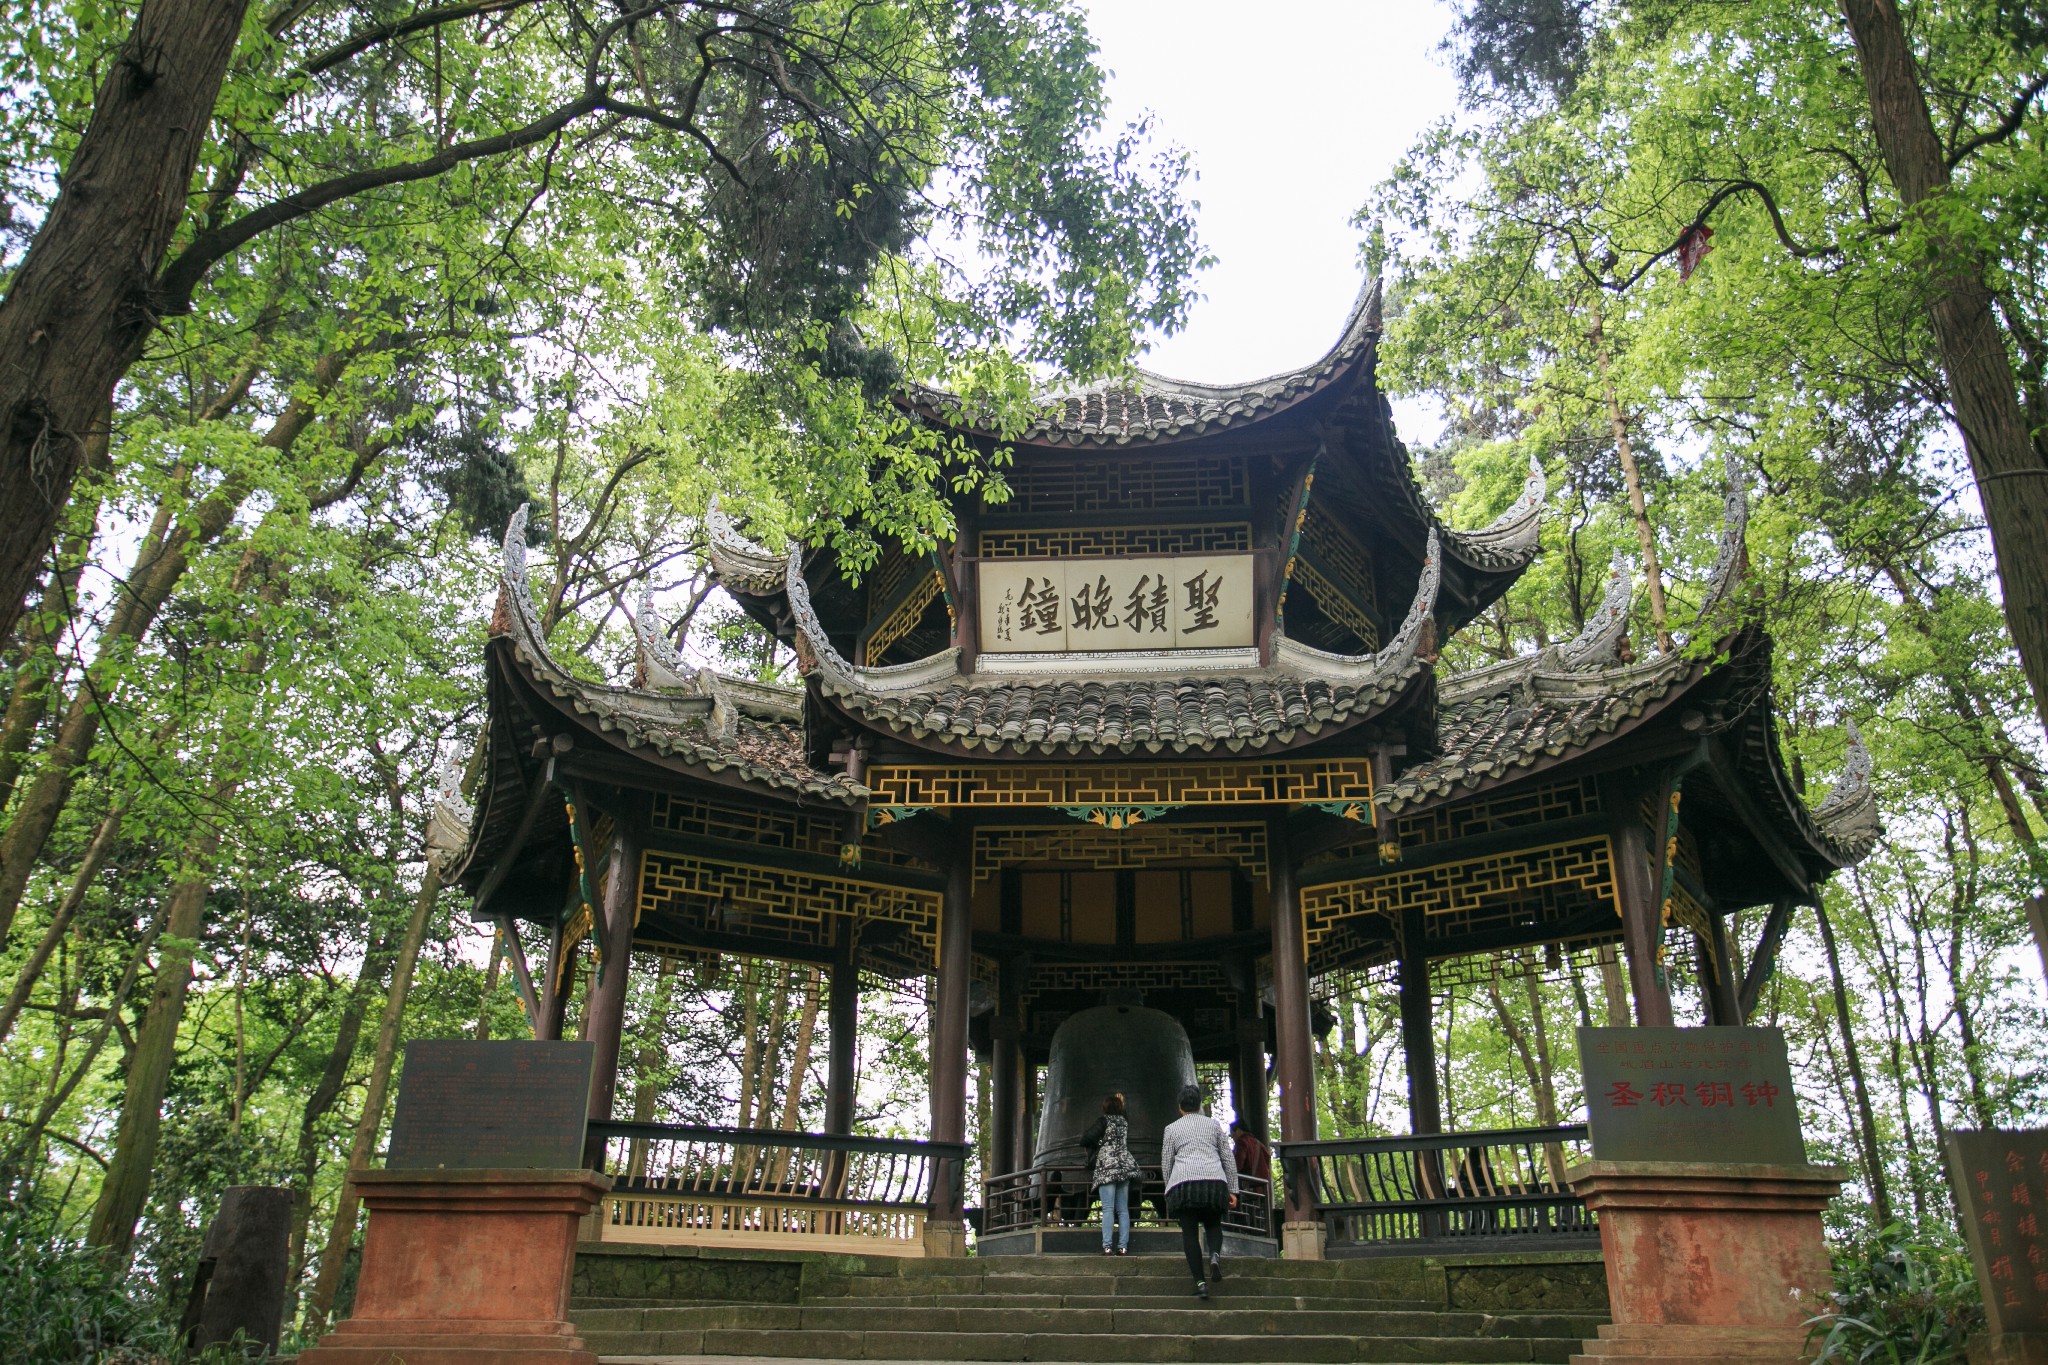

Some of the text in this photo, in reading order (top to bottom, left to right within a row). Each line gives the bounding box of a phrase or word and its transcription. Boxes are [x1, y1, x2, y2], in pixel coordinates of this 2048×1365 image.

[1597, 1040, 1771, 1055] 全国重点文物保护单位
[1604, 1081, 1780, 1108] 圣积铜钟
